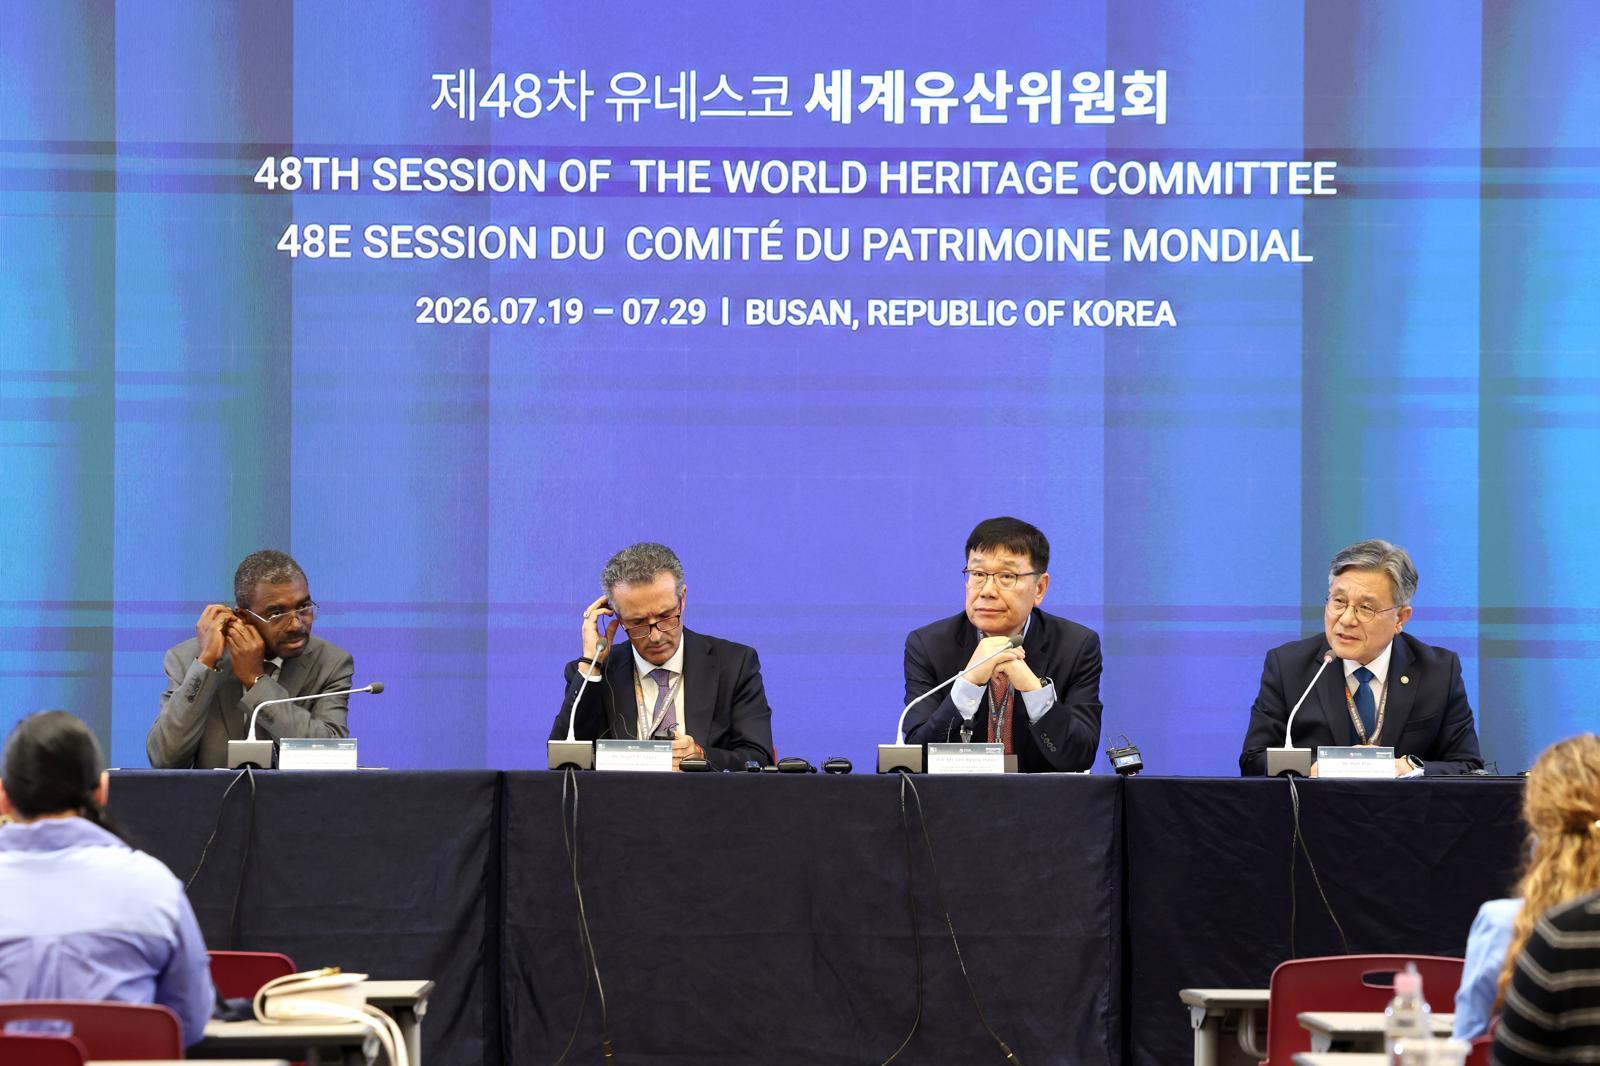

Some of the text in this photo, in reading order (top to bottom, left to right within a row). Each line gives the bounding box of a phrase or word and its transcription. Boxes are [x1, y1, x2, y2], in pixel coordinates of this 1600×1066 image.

[430, 68, 1167, 125] 제48차 유네스코 세계유산위원회
[253, 156, 1337, 195] 48TH SESSION OF THE WORLD HERITAGE COMMITTEE
[276, 219, 1314, 263] 48E SESSION DU COMITÉ DU PATRIMOINE MONDIAL
[415, 296, 584, 325] 2026.07.19
[622, 297, 707, 326] 07.29
[745, 298, 859, 331] BUSAN,
[867, 299, 1018, 327] REPUBLIC
[1024, 299, 1066, 327] OF
[1072, 299, 1177, 327] KOREA
